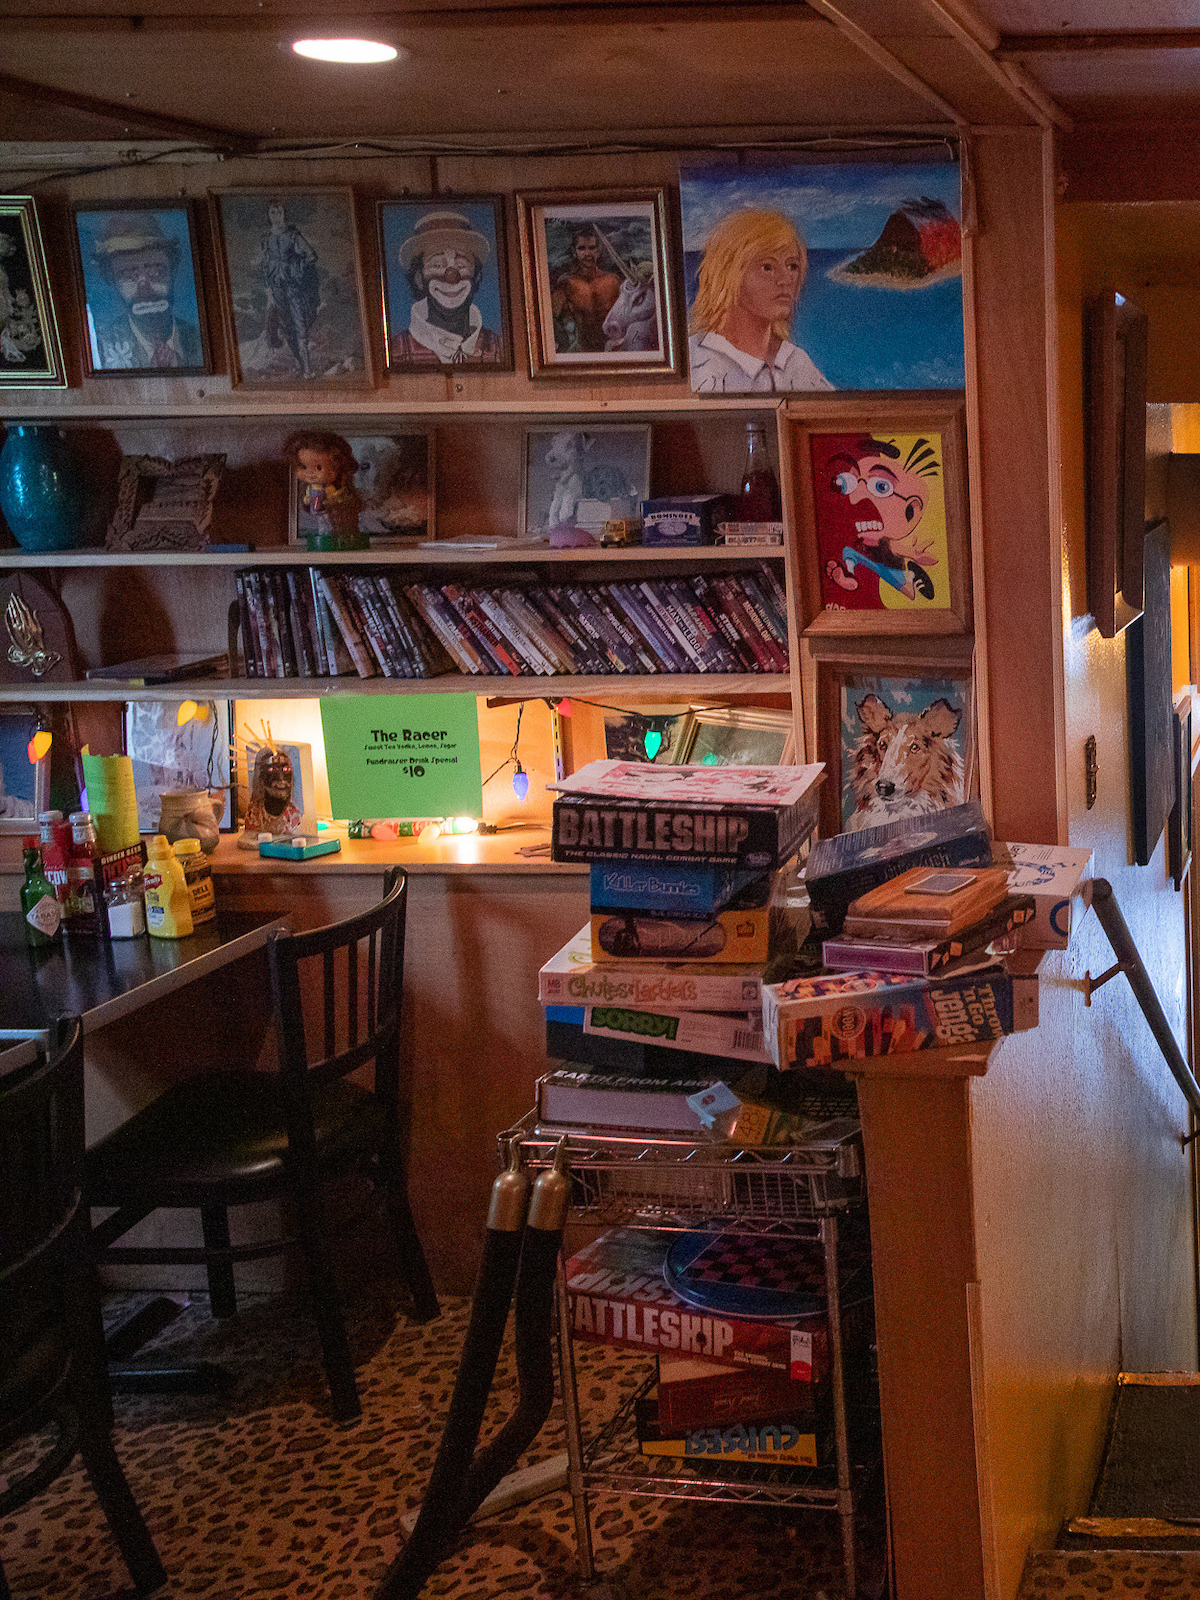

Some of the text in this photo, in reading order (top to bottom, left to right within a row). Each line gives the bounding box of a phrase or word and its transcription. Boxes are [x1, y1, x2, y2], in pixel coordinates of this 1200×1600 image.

[666, 605, 703, 655] MAN LEDGE
[371, 729, 448, 742] The Racer
[366, 757, 408, 765] Fundraiser
[431, 756, 458, 764] Special
[403, 765, 426, 777] $10
[558, 808, 749, 852] BATTLESHIP
[564, 850, 738, 864] THE CLASSIC NAVAL COMBAT GAME
[568, 977, 629, 1001] Chutes
[634, 978, 697, 1002] Ladders
[591, 1006, 680, 1041] SORRY!
[930, 989, 976, 1044] Jenga
[617, 1076, 671, 1088] FROM
[568, 1295, 734, 1356] ATTLESHIP
[685, 1424, 800, 1455] CURSES!
